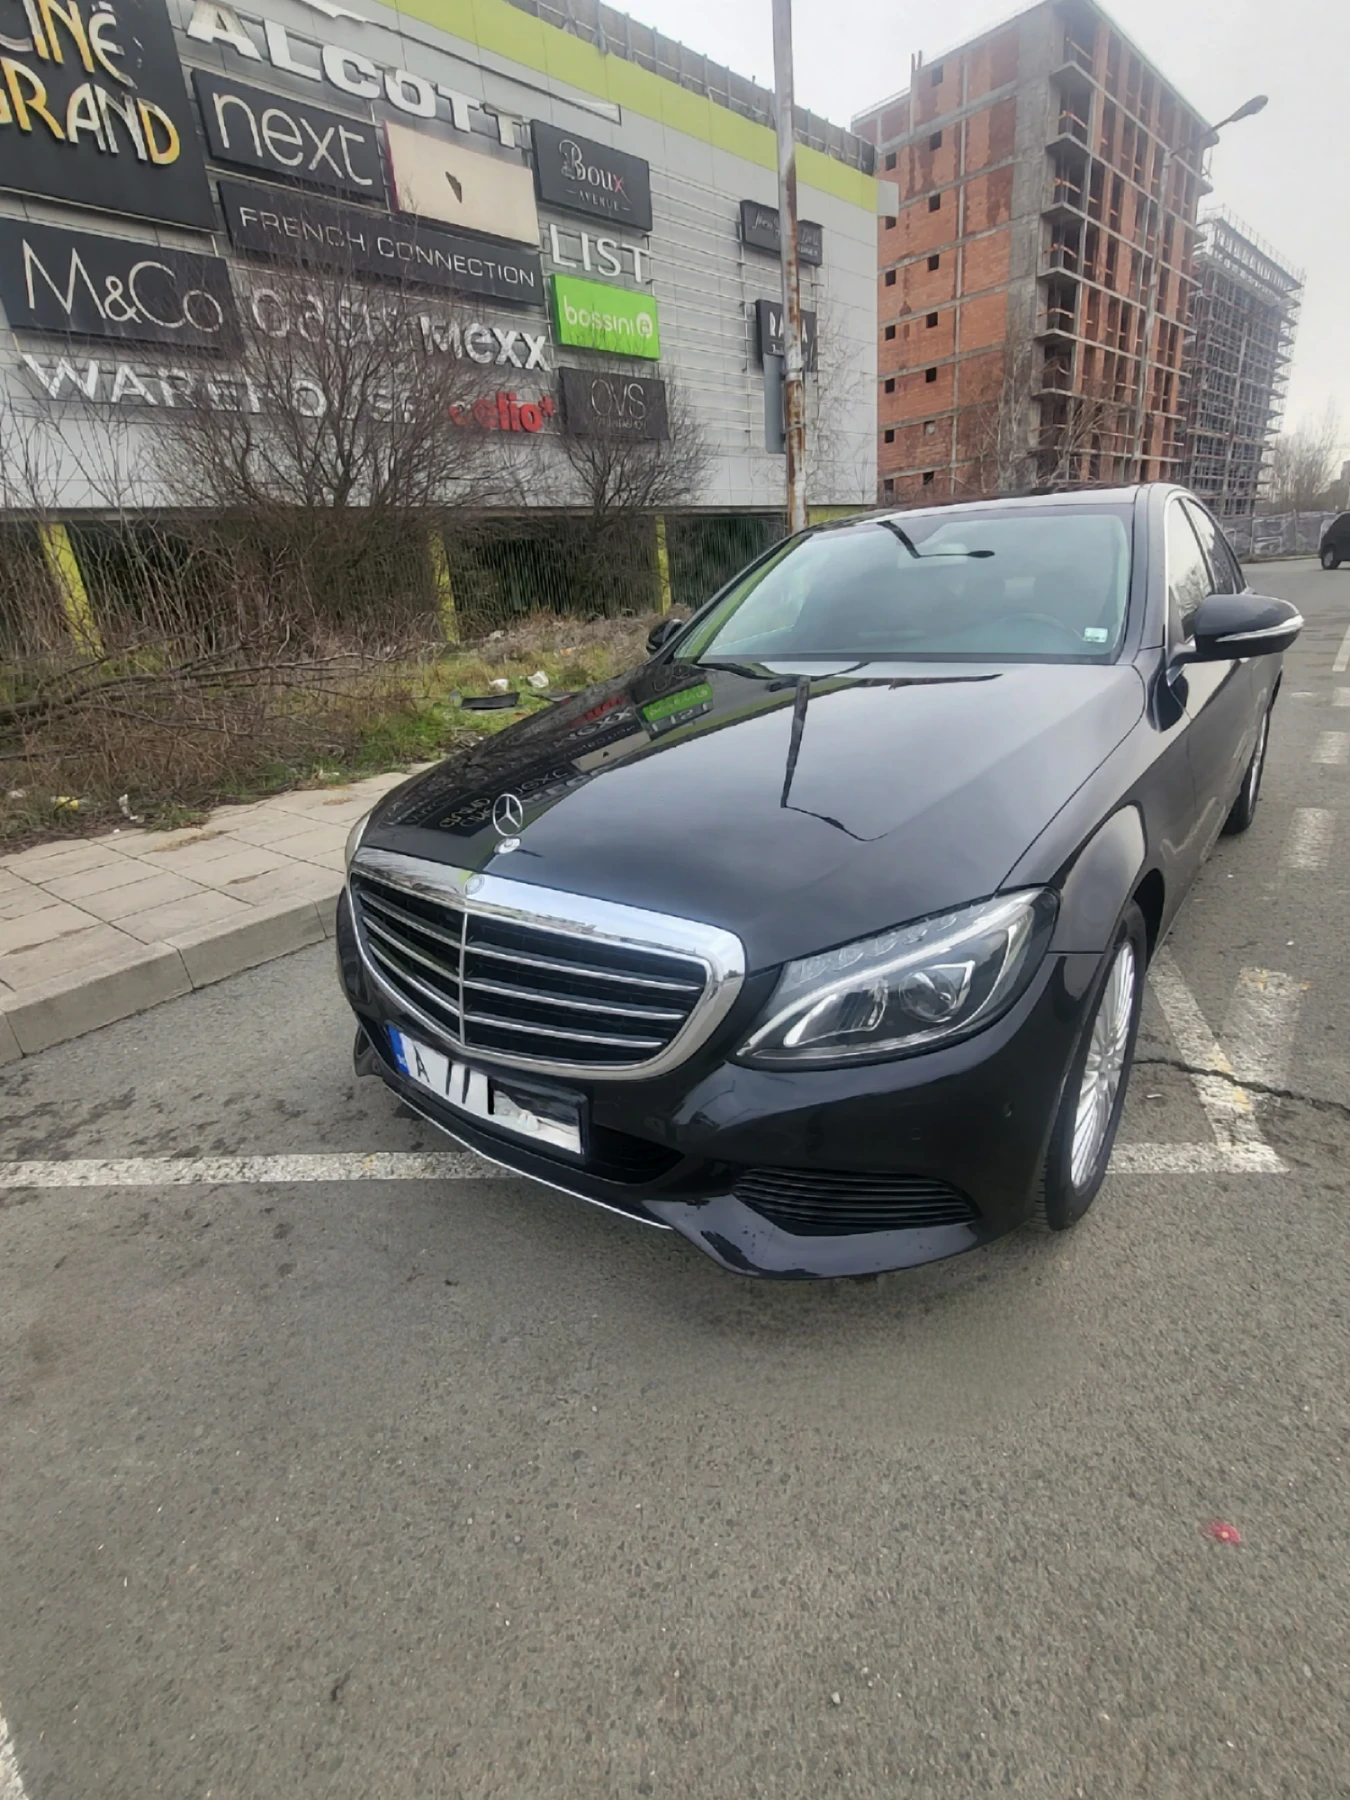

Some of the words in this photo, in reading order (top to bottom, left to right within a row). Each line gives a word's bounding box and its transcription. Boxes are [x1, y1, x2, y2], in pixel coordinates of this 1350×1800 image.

[0, 56, 181, 165] RAND
[187, 4, 522, 149] ALCOTT
[213, 92, 373, 186] next
[559, 139, 633, 204] Boux
[22, 239, 224, 334] M&Co
[239, 206, 366, 252] FRENCH
[377, 236, 535, 288] CONNECTION
[550, 224, 651, 284] LIST
[563, 294, 635, 337] bossini
[591, 379, 647, 420] OVS
